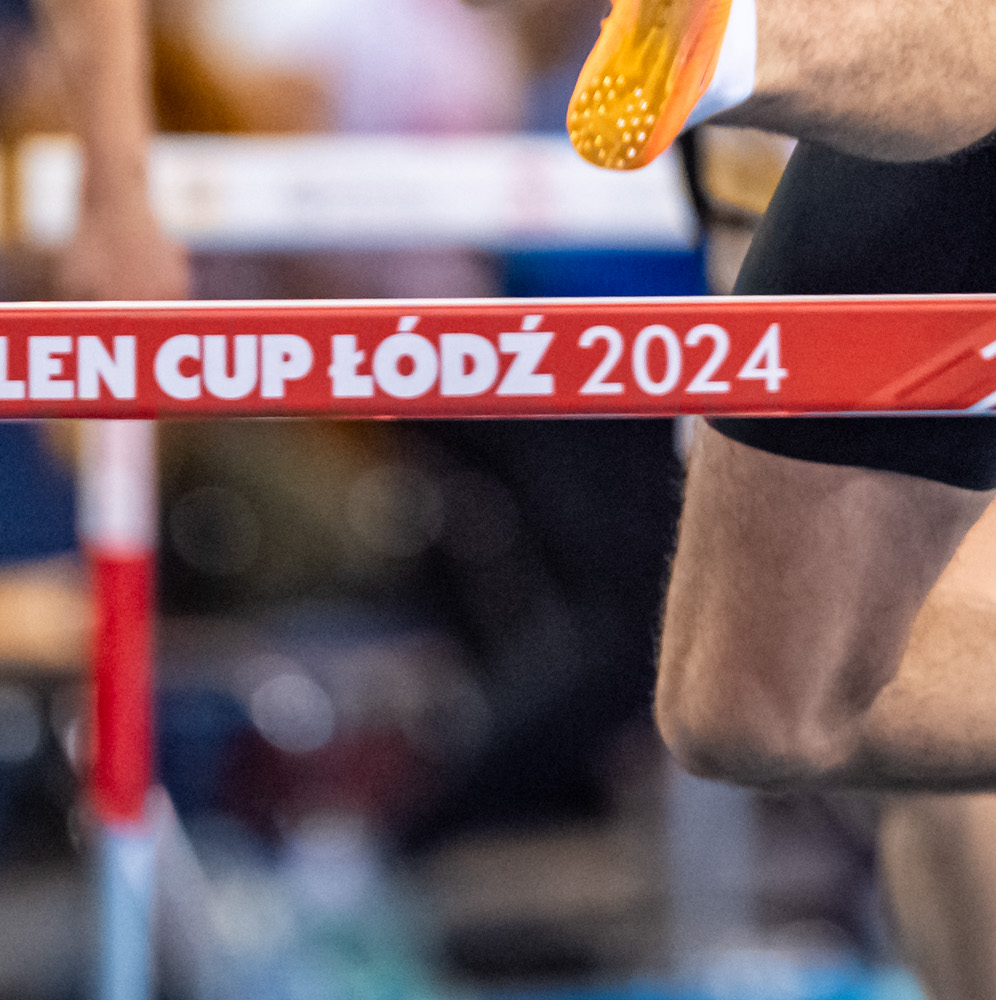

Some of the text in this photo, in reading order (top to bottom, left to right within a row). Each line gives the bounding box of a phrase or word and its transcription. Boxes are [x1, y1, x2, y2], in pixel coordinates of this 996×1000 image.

[153, 333, 314, 400] CUP
[328, 315, 555, 398] ŁÓDŹ
[577, 322, 788, 394] 2024
